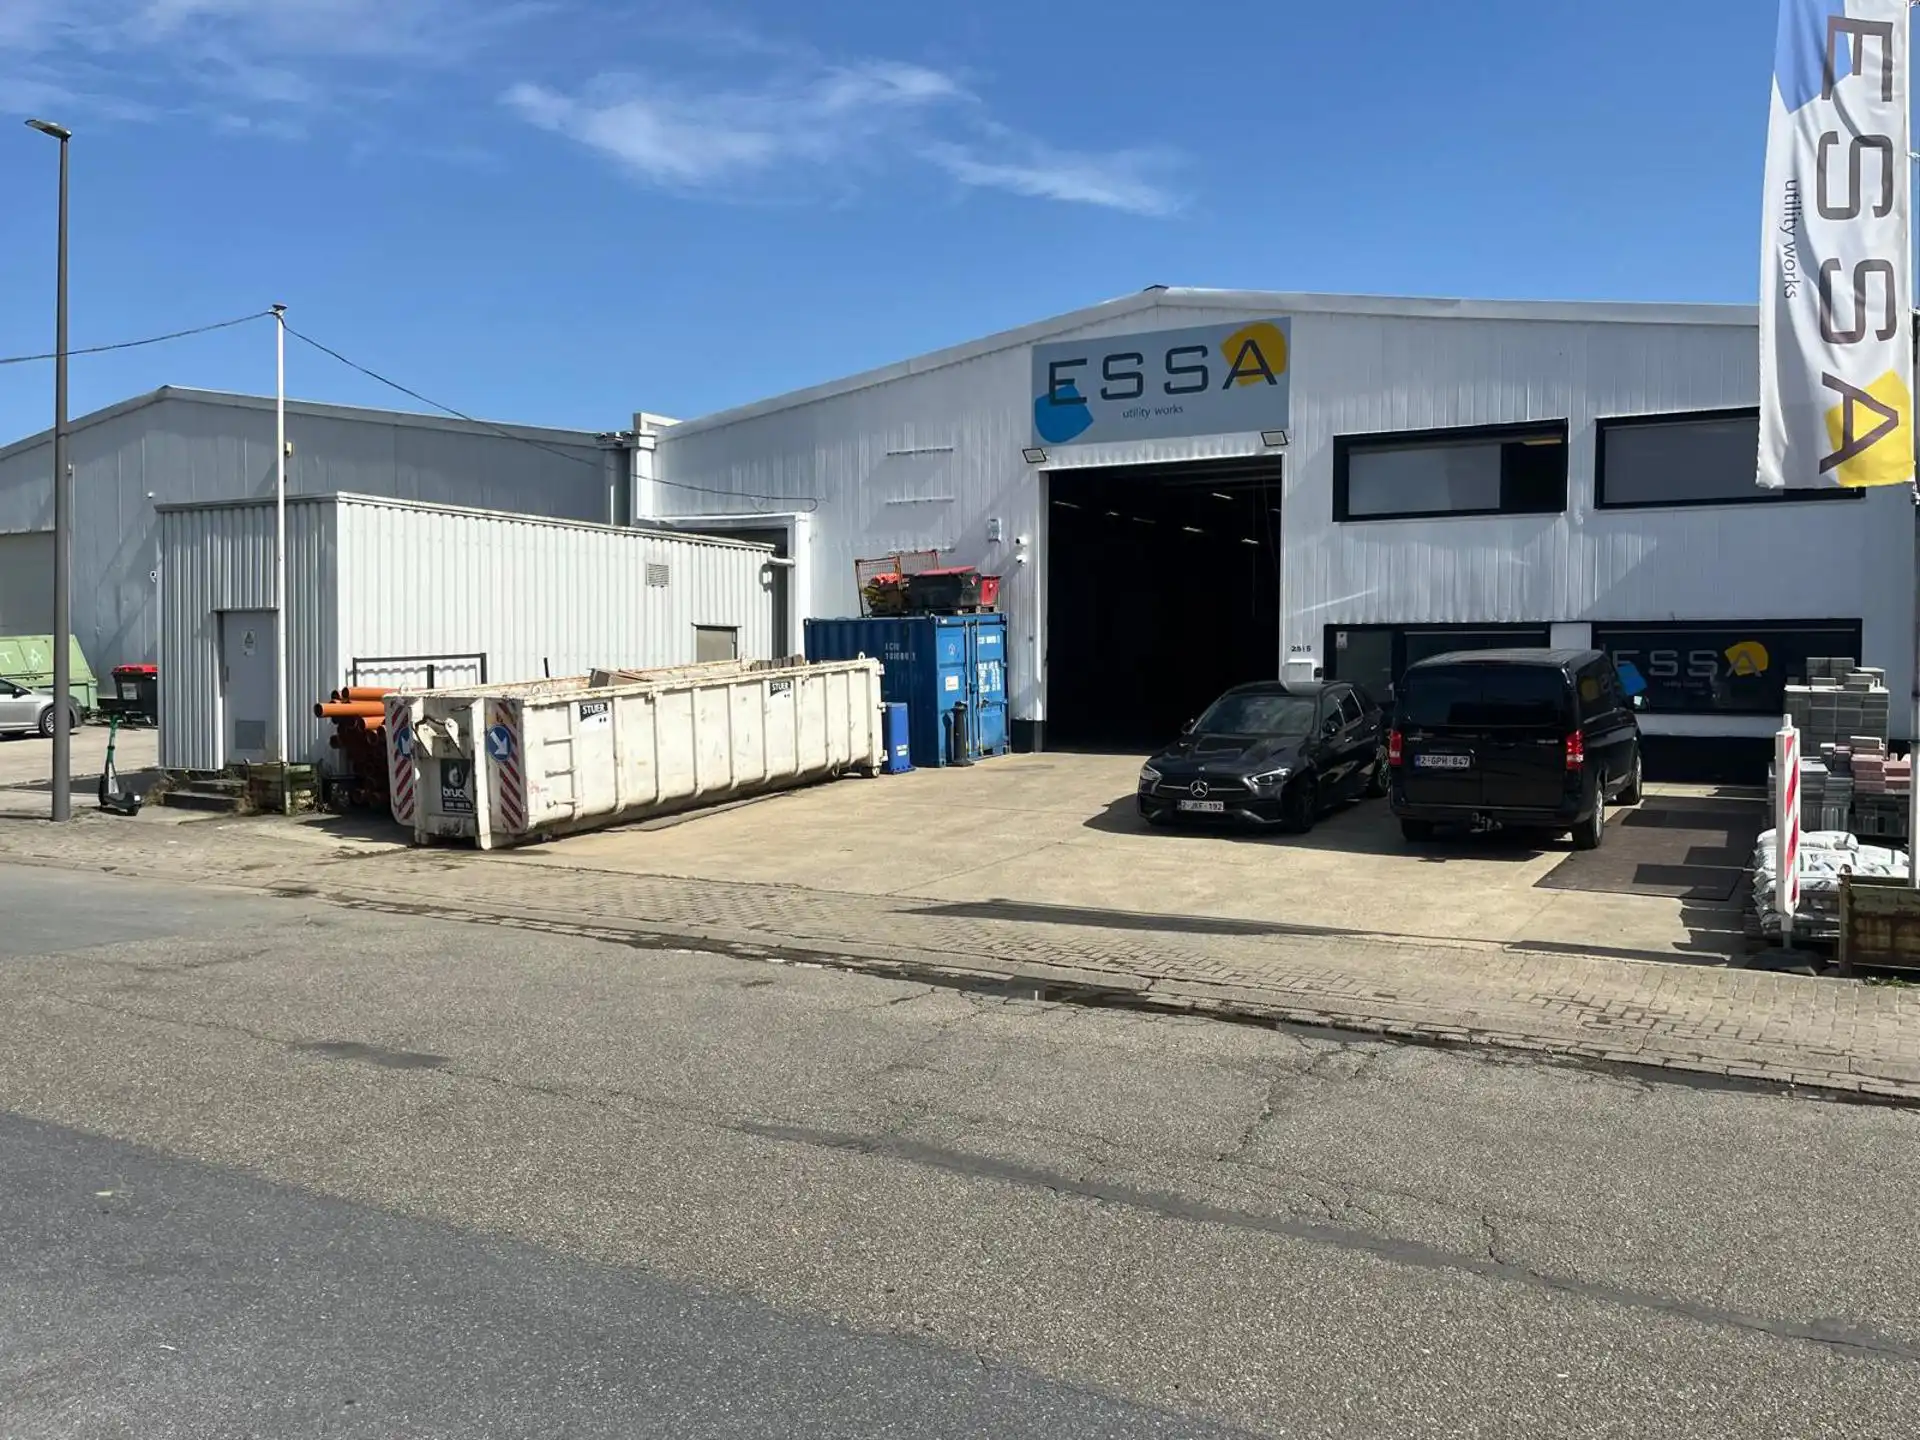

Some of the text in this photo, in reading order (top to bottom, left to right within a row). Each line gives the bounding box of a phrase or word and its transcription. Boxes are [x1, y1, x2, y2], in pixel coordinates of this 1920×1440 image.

[1780, 180, 1802, 299] utility works
[1817, 15, 1899, 475] ESSA
[1049, 339, 1278, 405] ESSA
[1122, 404, 1184, 420] utility works
